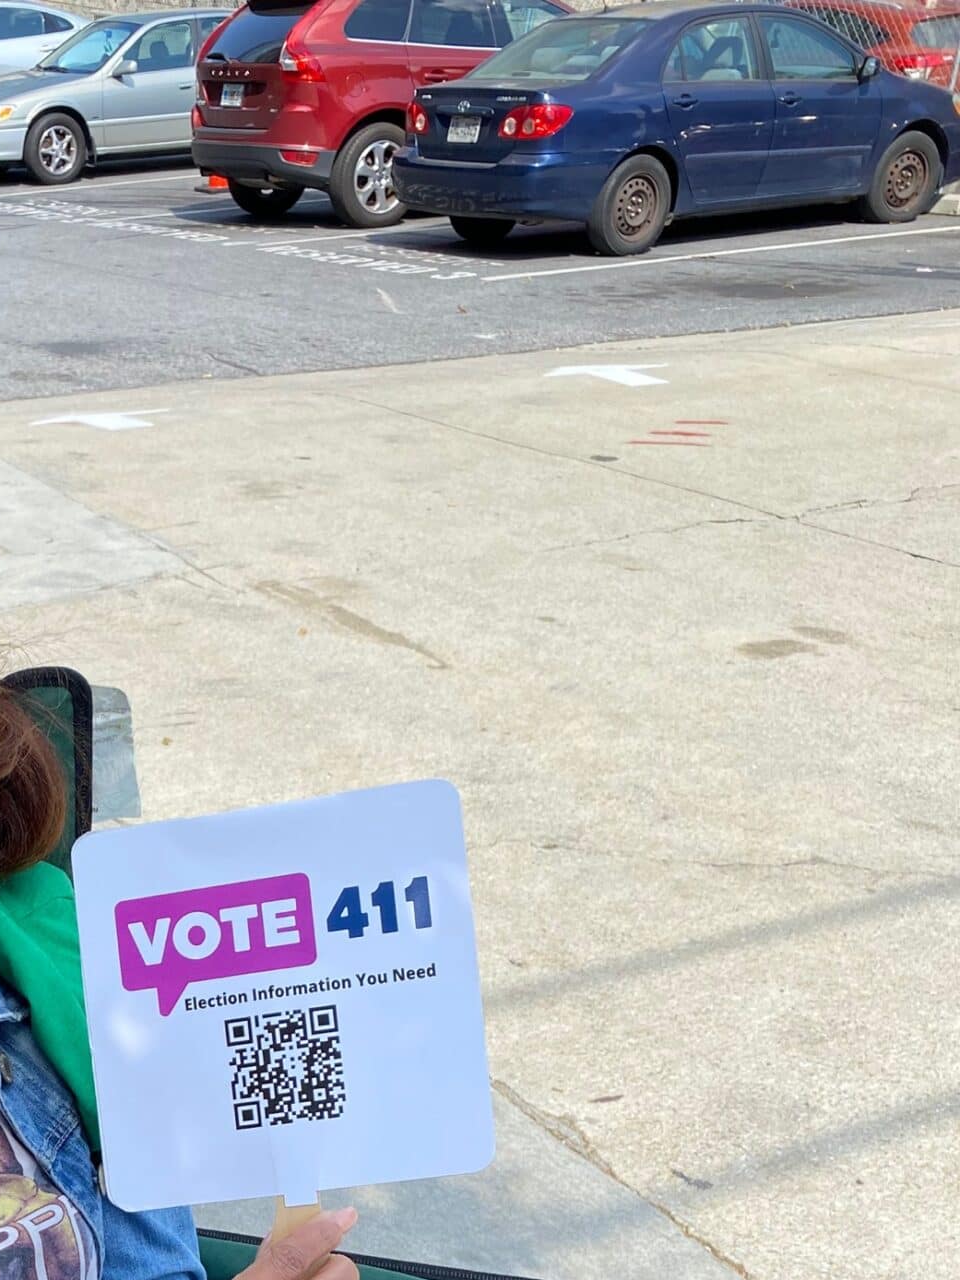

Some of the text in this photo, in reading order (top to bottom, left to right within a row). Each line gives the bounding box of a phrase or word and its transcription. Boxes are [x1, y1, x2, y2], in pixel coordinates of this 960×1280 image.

[127, 875, 433, 967] VOTE 411
[184, 963, 437, 1012] Election Information You Need
